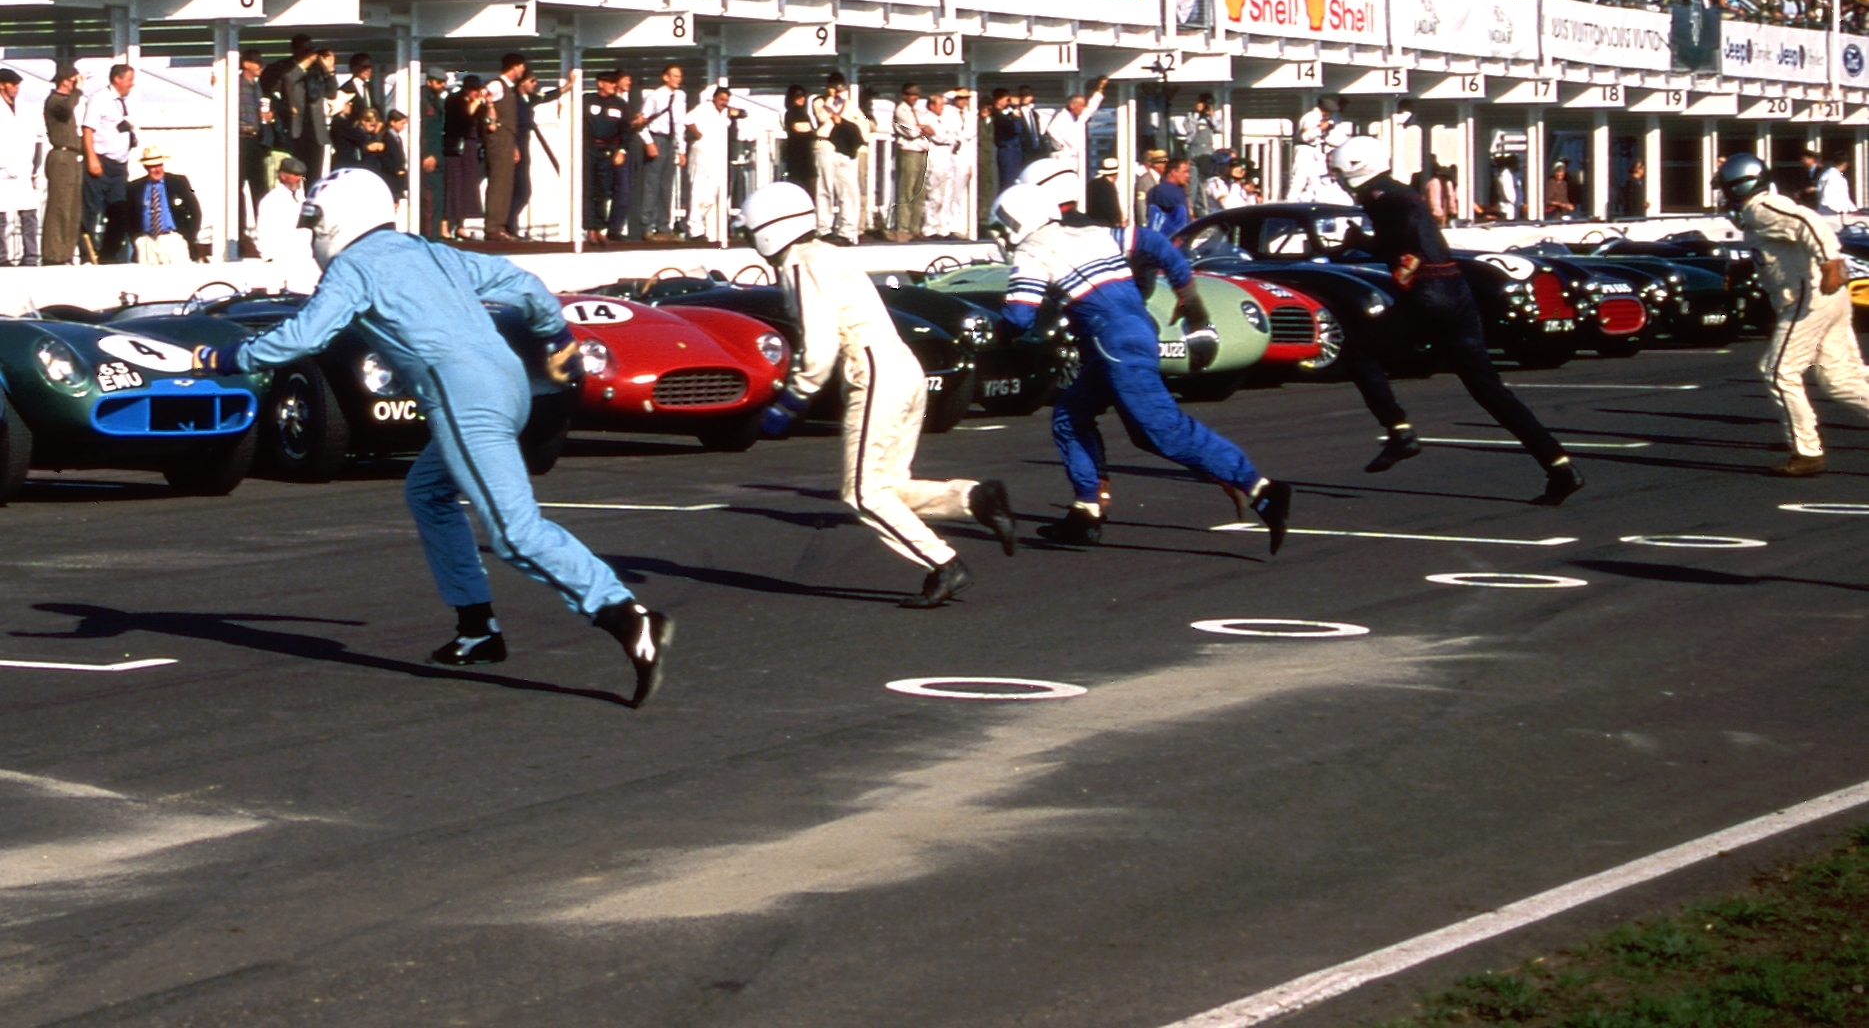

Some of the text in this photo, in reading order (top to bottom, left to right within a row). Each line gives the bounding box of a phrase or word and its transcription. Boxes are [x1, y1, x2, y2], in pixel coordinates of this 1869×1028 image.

[514, 5, 527, 27] 7
[673, 16, 685, 38] 8
[816, 26, 828, 47] 9
[933, 36, 955, 56] 10
[1059, 45, 1071, 64] 11
[1724, 36, 1745, 66] Jeep
[1777, 42, 1798, 70] Jeep
[1296, 63, 1315, 81] 14
[1384, 70, 1401, 87] 15
[1461, 75, 1479, 92] 16
[1534, 82, 1550, 97] 17
[1602, 86, 1619, 102] 18
[1665, 91, 1682, 106] 19
[1767, 99, 1788, 114] 20
[1825, 103, 1839, 117] 21
[1486, 257, 1519, 272] 2
[575, 304, 617, 322] 14
[128, 340, 168, 361] 4
[100, 362, 129, 377] 63
[100, 372, 143, 392] EMU
[984, 378, 1021, 397] YPG 3
[374, 400, 417, 421] OVC
